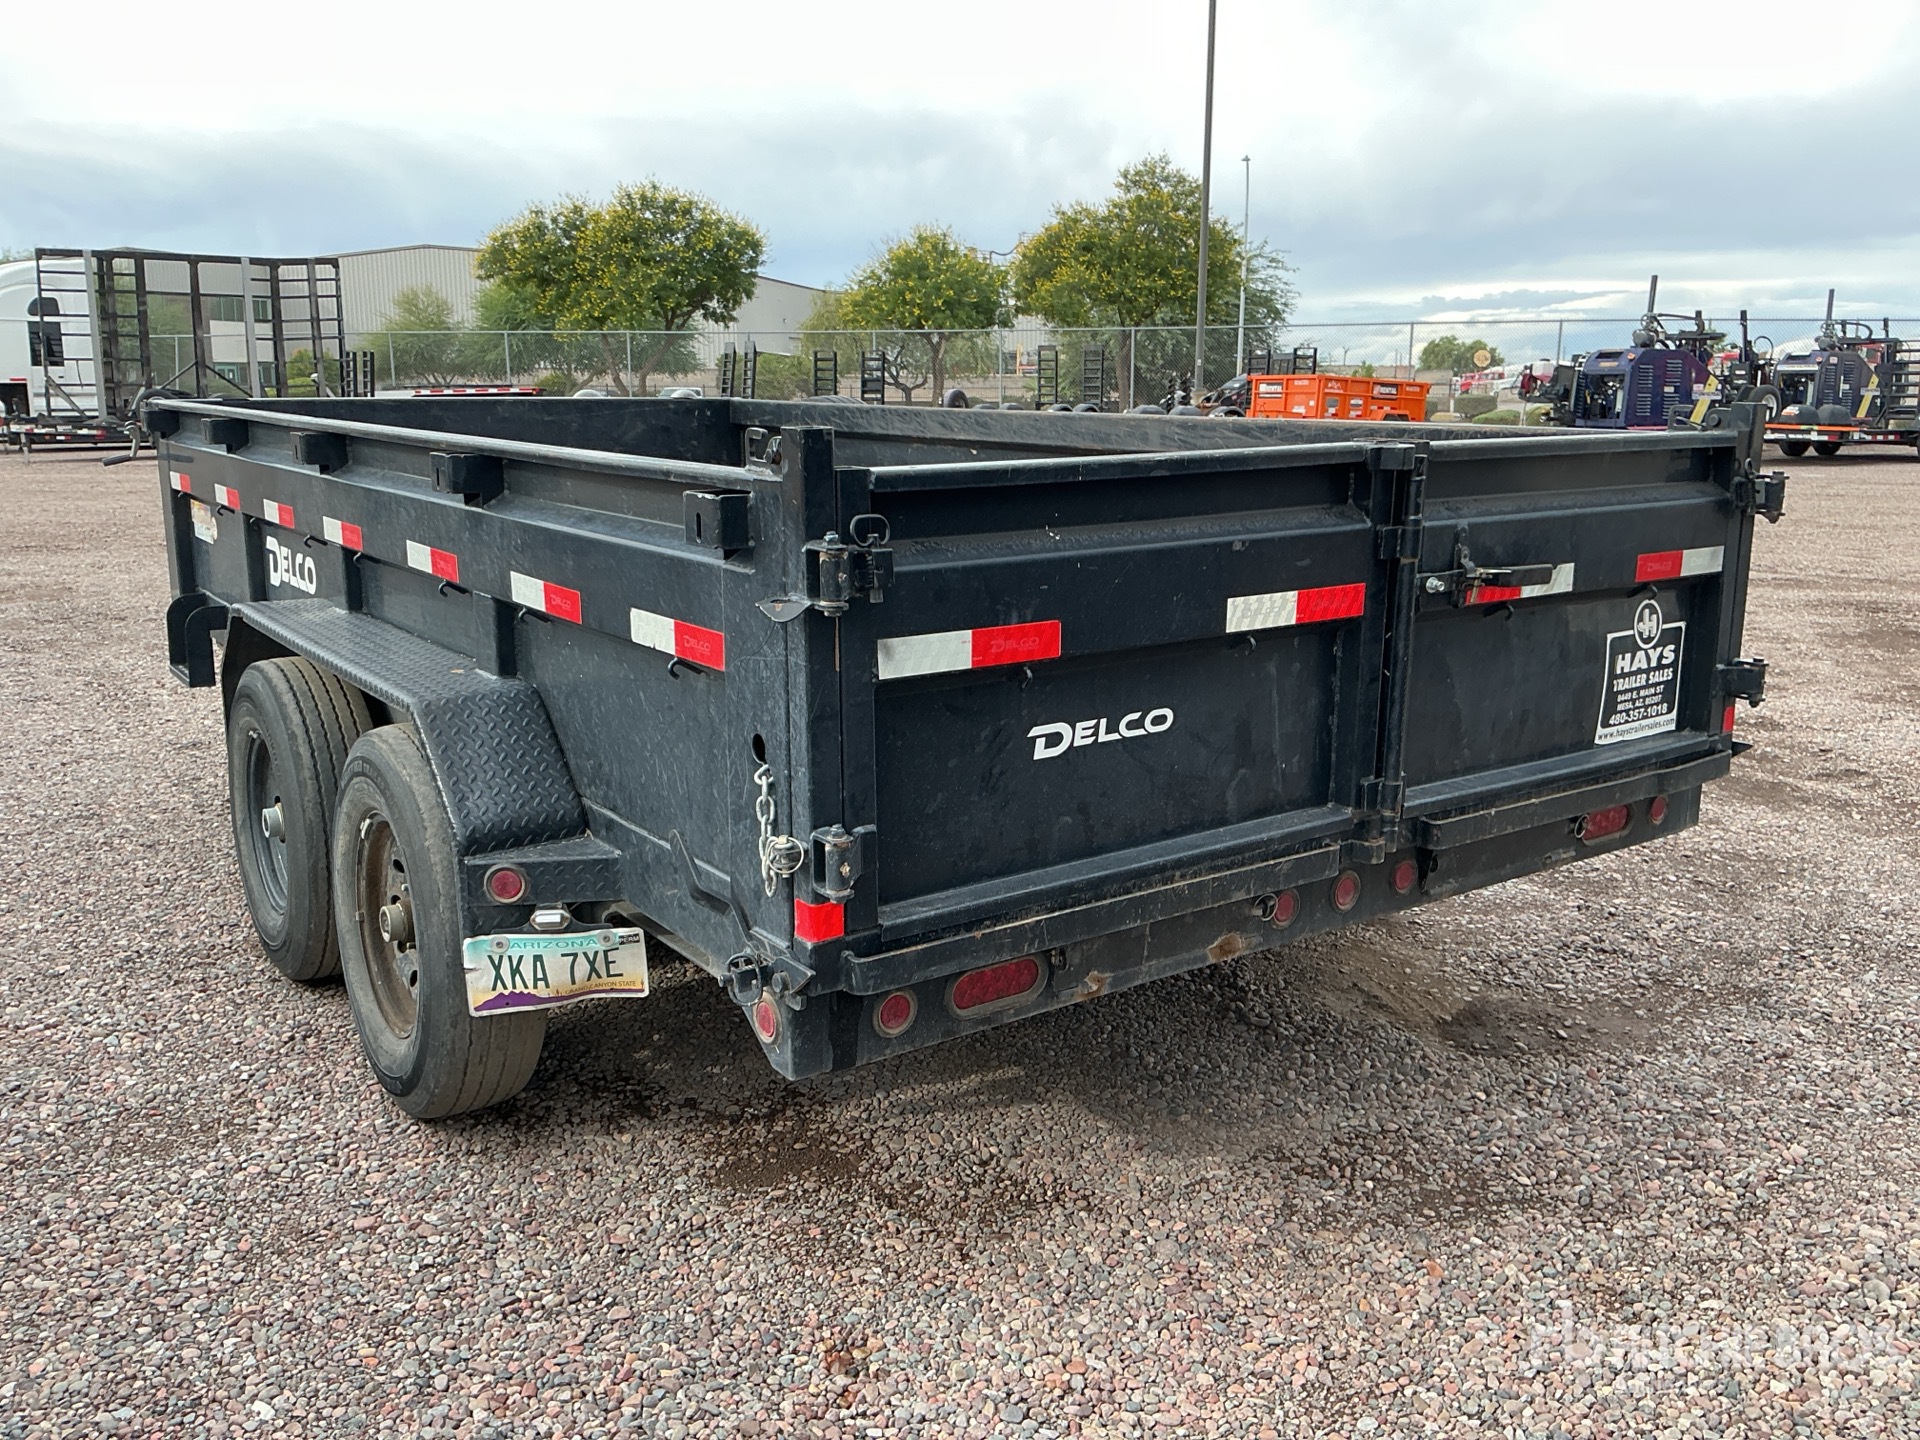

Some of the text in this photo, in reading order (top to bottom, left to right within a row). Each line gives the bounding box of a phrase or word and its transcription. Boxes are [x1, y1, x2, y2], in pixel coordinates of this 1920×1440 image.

[266, 535, 317, 595] DELCO
[682, 634, 712, 652] DELCO
[990, 636, 1040, 654] DELCO
[1614, 644, 1676, 675] HAYS
[1612, 667, 1674, 692] TRAILER SALES
[1639, 687, 1656, 697] MAIN
[1655, 684, 1665, 694] ST
[1608, 702, 1669, 726] 480-357-1018
[1027, 707, 1174, 760] DELCO
[1597, 717, 1675, 740] www.haystrailersales.com
[510, 938, 598, 950] ARIZONA
[487, 947, 624, 991] XKA 7XE
[564, 980, 637, 995] GRAND CANYON STATE
